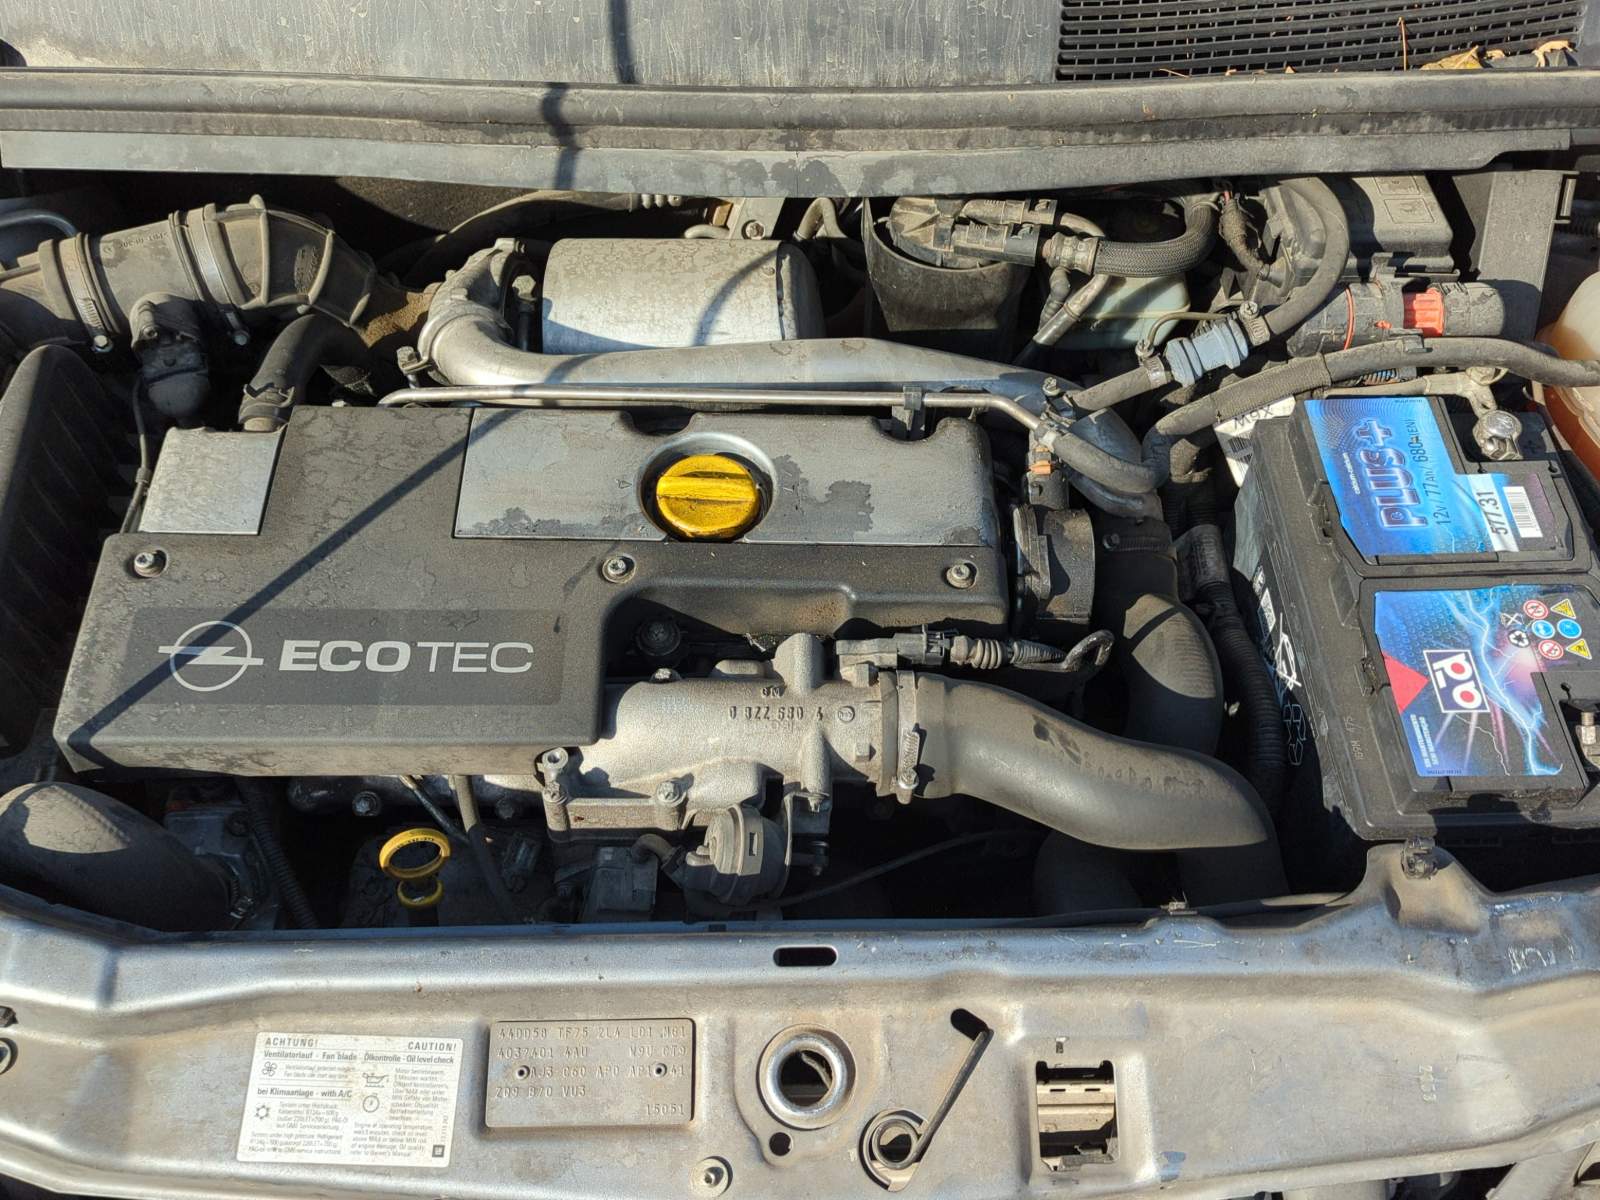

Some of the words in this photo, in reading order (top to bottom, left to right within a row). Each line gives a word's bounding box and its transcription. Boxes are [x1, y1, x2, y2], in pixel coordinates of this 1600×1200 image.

[1477, 490, 1508, 536] 577.31
[279, 639, 534, 673] ECOTEC
[265, 1037, 320, 1047] ACHTUNG!
[408, 1041, 457, 1051] CAUTION!
[322, 1051, 335, 1060] Fan
[337, 1051, 357, 1061] blade
[406, 1055, 416, 1063] Oil
[417, 1055, 432, 1063] level
[433, 1056, 454, 1064] check
[257, 1087, 269, 1095] bei
[270, 1087, 314, 1098] Klimaanlage
[321, 1089, 337, 1097] with
[337, 1089, 353, 1098] A/C
[647, 1104, 685, 1116] 15051
